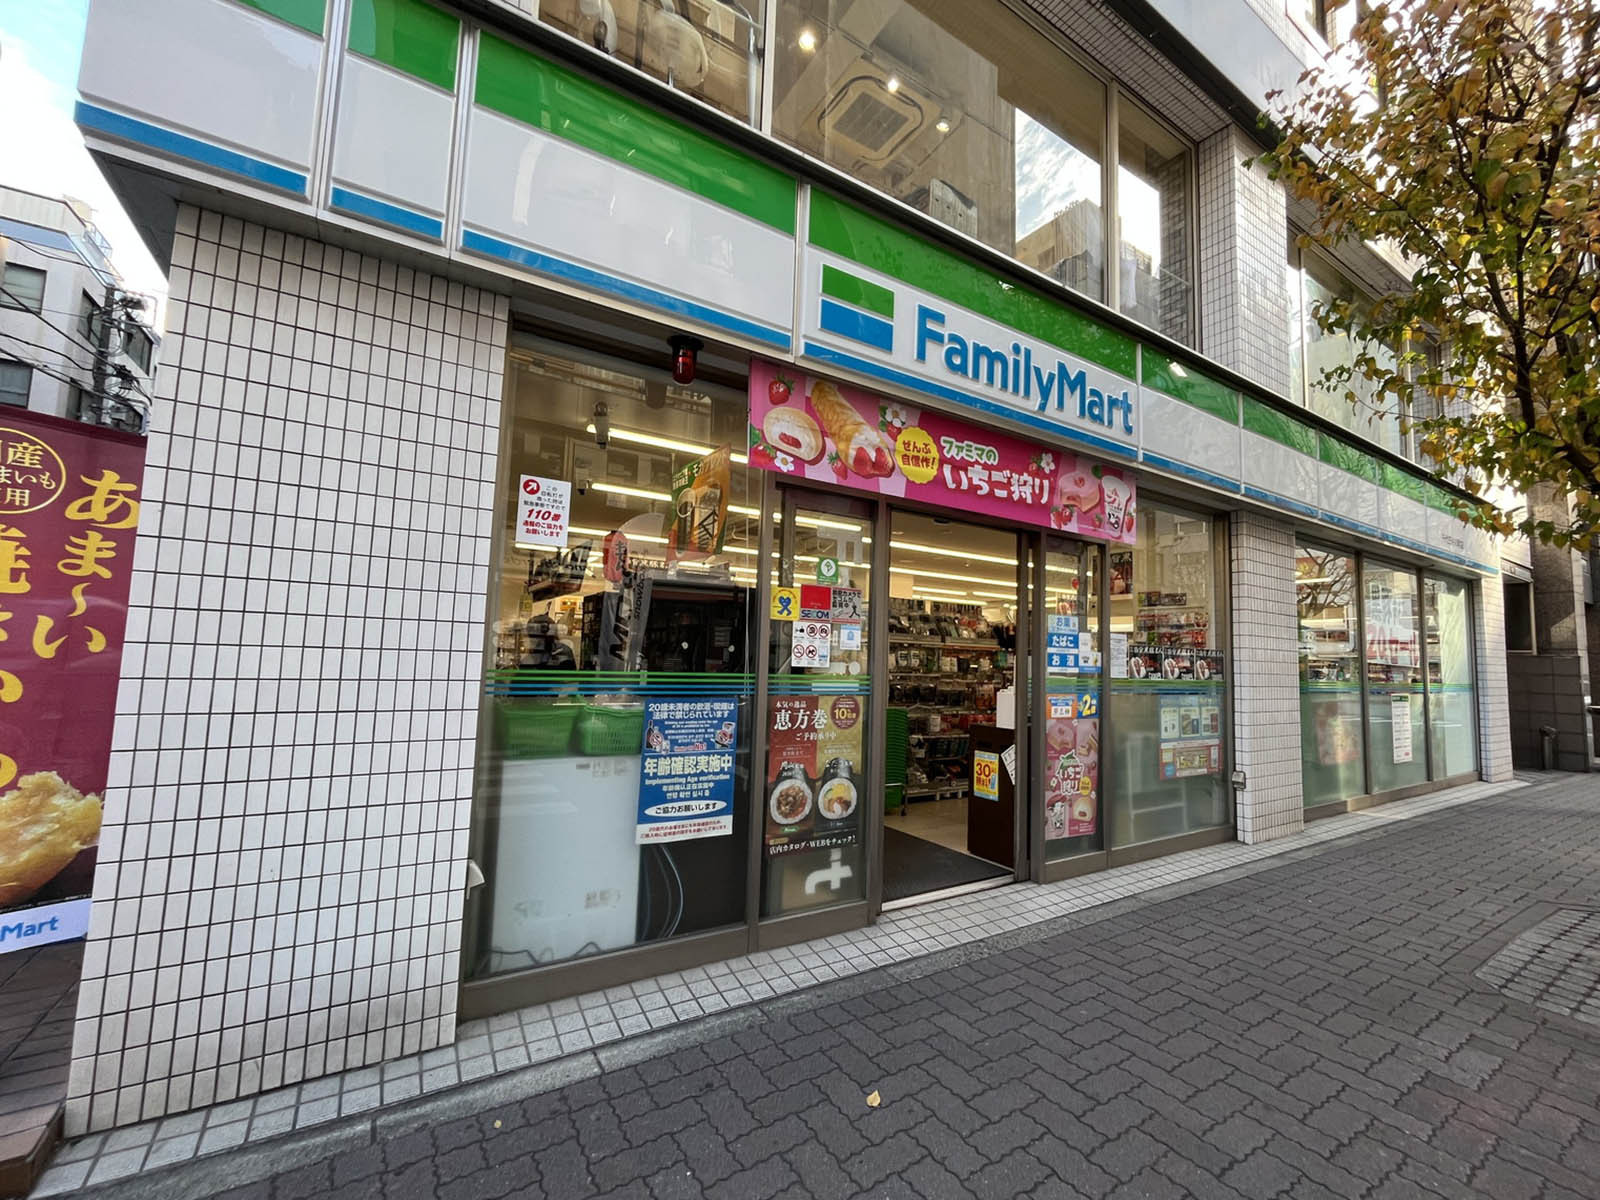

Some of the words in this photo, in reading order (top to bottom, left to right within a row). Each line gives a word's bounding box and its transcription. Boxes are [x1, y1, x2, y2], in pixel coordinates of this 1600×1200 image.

[915, 304, 1134, 435] FamilyMart
[0, 440, 44, 469] 産
[941, 436, 999, 465] ファミマの
[901, 454, 936, 470] 自信作!
[943, 464, 1050, 504] いちご狩り
[0, 487, 31, 507] 用
[527, 508, 562, 522] 110番
[525, 528, 561, 538] お願いします
[801, 609, 830, 619] SECOM
[1051, 635, 1075, 648] たばこ
[774, 708, 828, 731] 恵方巻
[644, 753, 733, 777] 年齢確認実施中
[655, 802, 718, 815] ご協力お願いします
